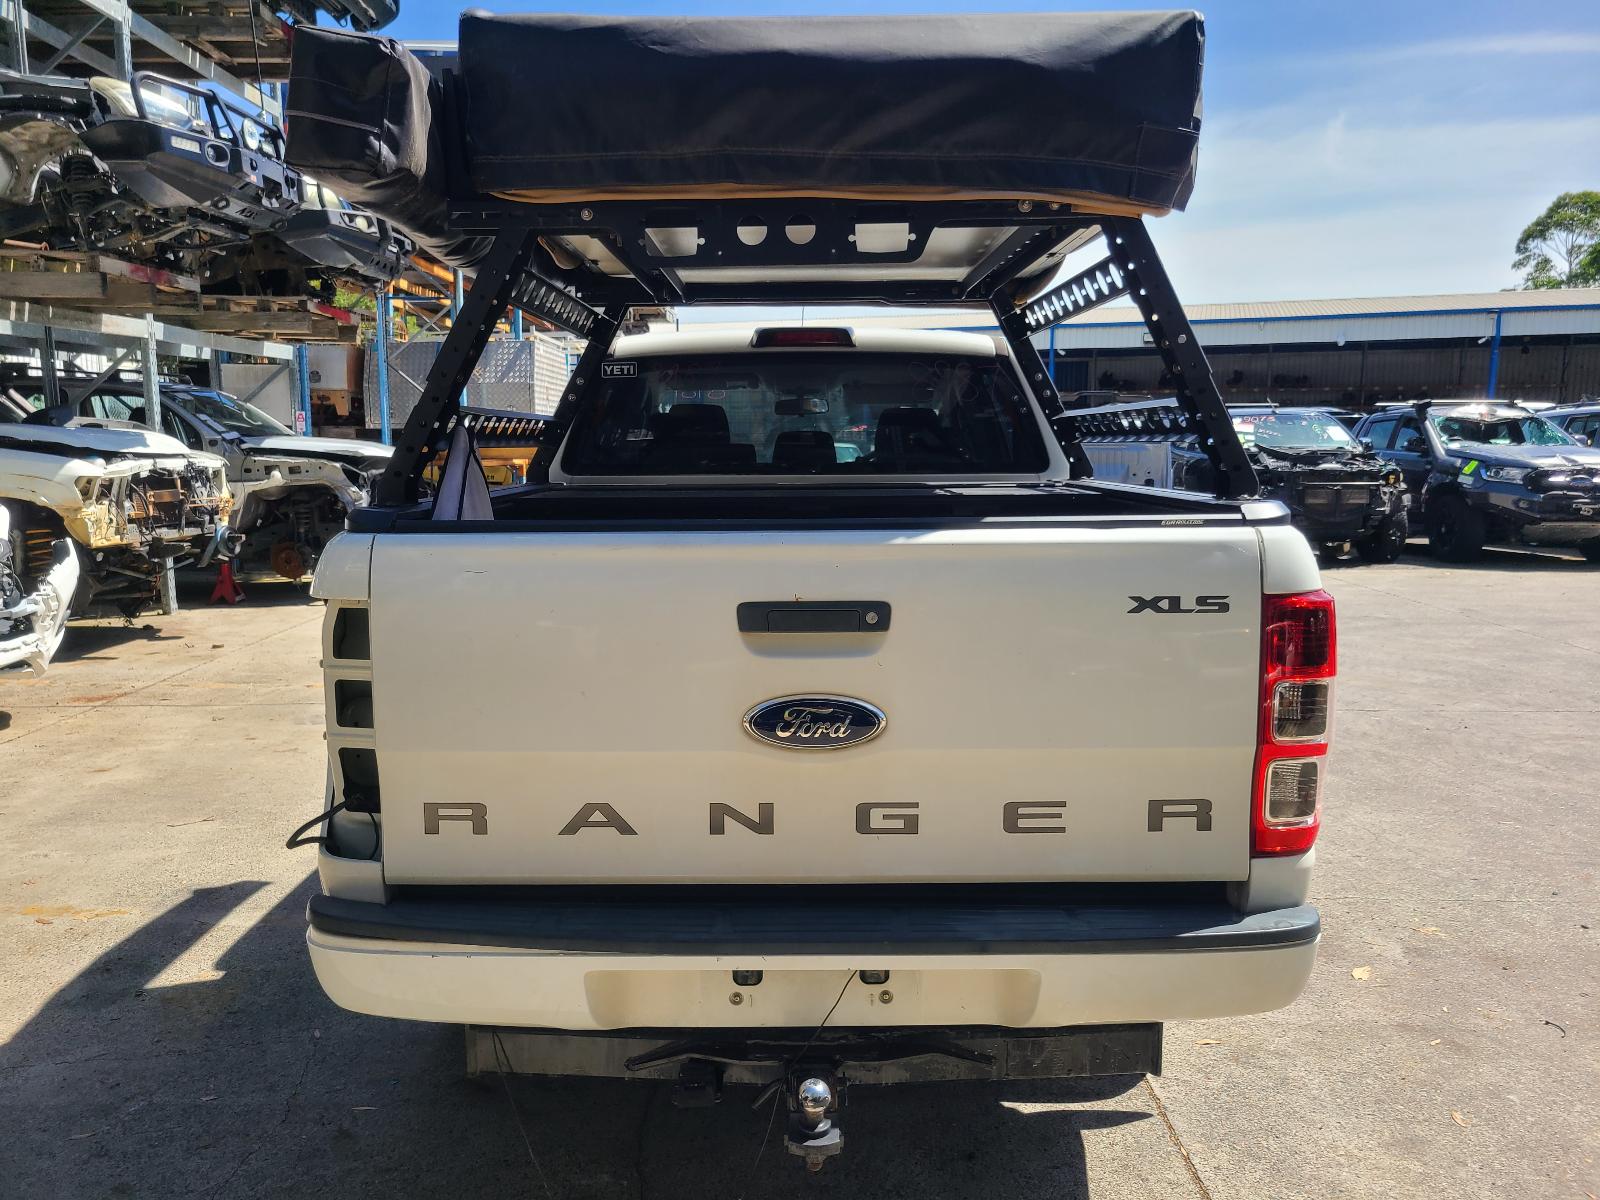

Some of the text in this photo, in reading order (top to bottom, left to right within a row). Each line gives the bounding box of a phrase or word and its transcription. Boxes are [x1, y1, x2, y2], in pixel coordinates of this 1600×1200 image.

[604, 365, 635, 375] YETI
[1128, 595, 1230, 613] XLS
[776, 707, 852, 738] Ford
[424, 799, 1213, 836] RANGER
